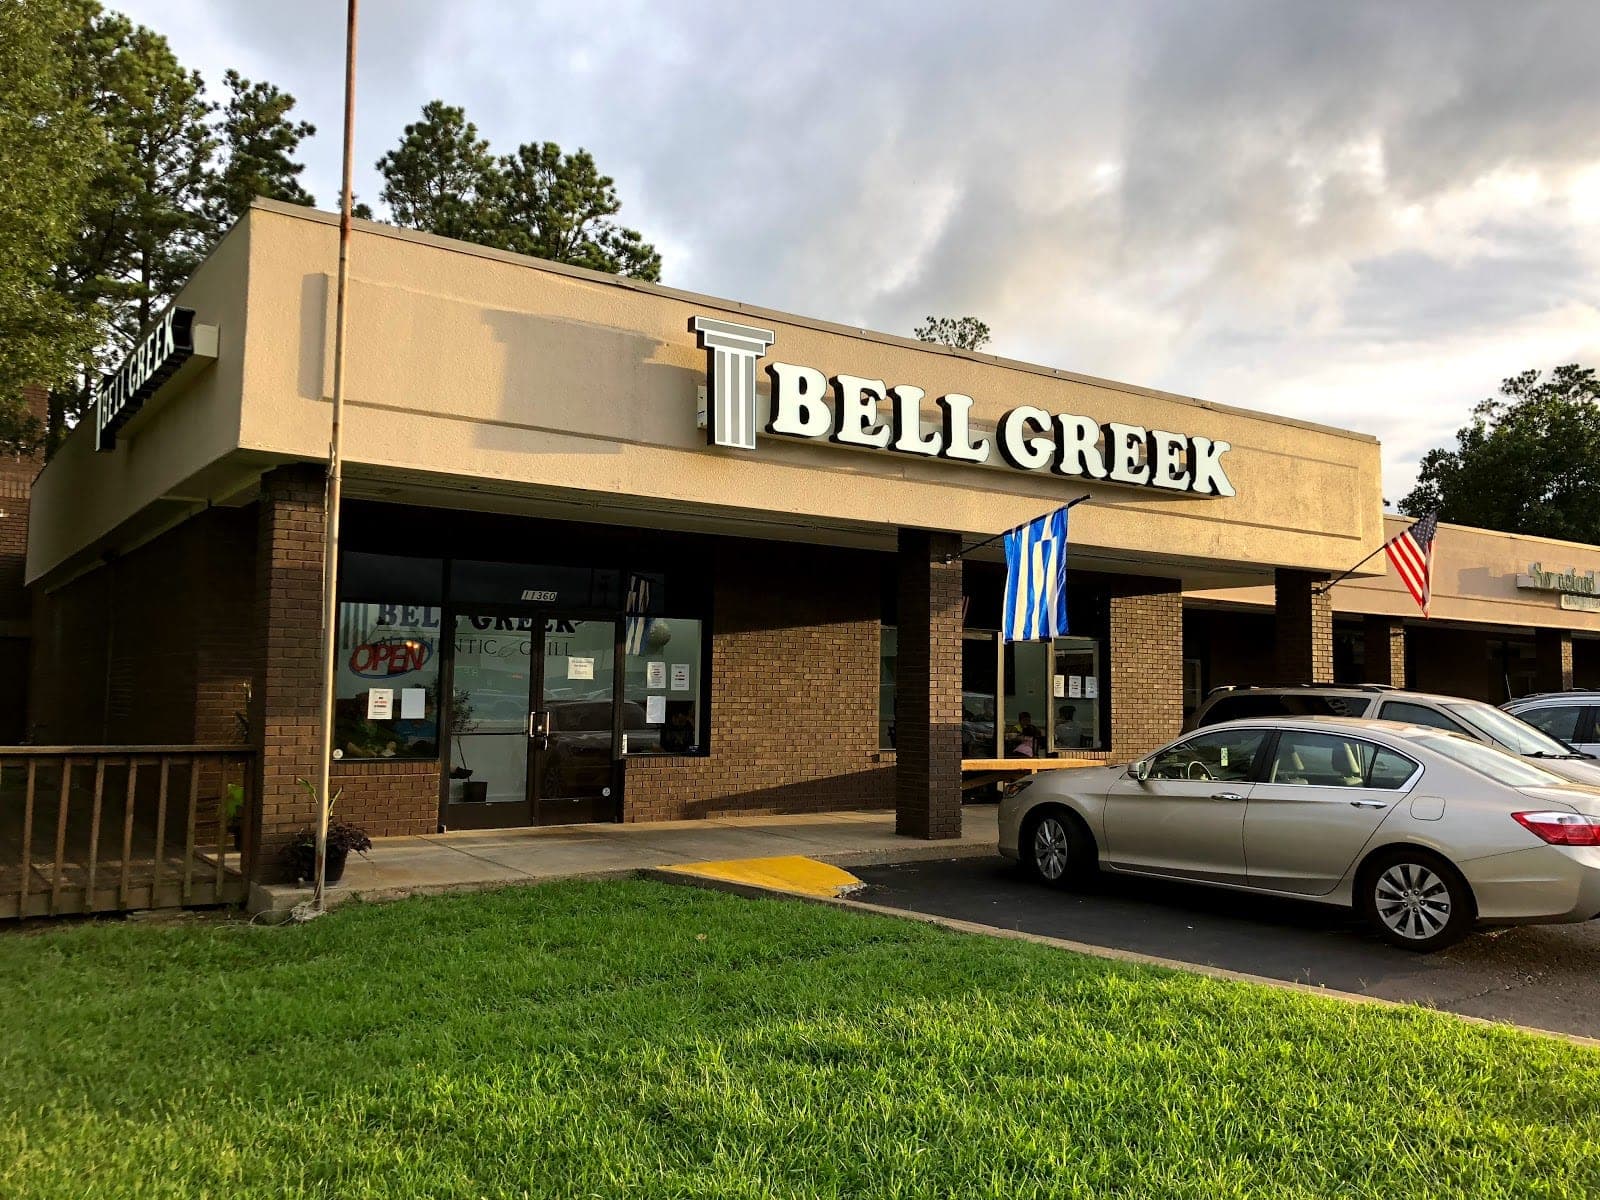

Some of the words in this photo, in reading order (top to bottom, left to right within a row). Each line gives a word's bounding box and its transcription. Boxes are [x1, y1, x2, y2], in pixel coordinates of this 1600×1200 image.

[101, 367, 127, 430] BELL
[128, 306, 176, 398] GREEK
[765, 361, 991, 463] BELL
[997, 405, 1237, 497] GREEK
[524, 591, 556, 600] 11360
[471, 615, 580, 634] GREK
[350, 641, 427, 672] OPEN
[519, 641, 573, 657] GILL
